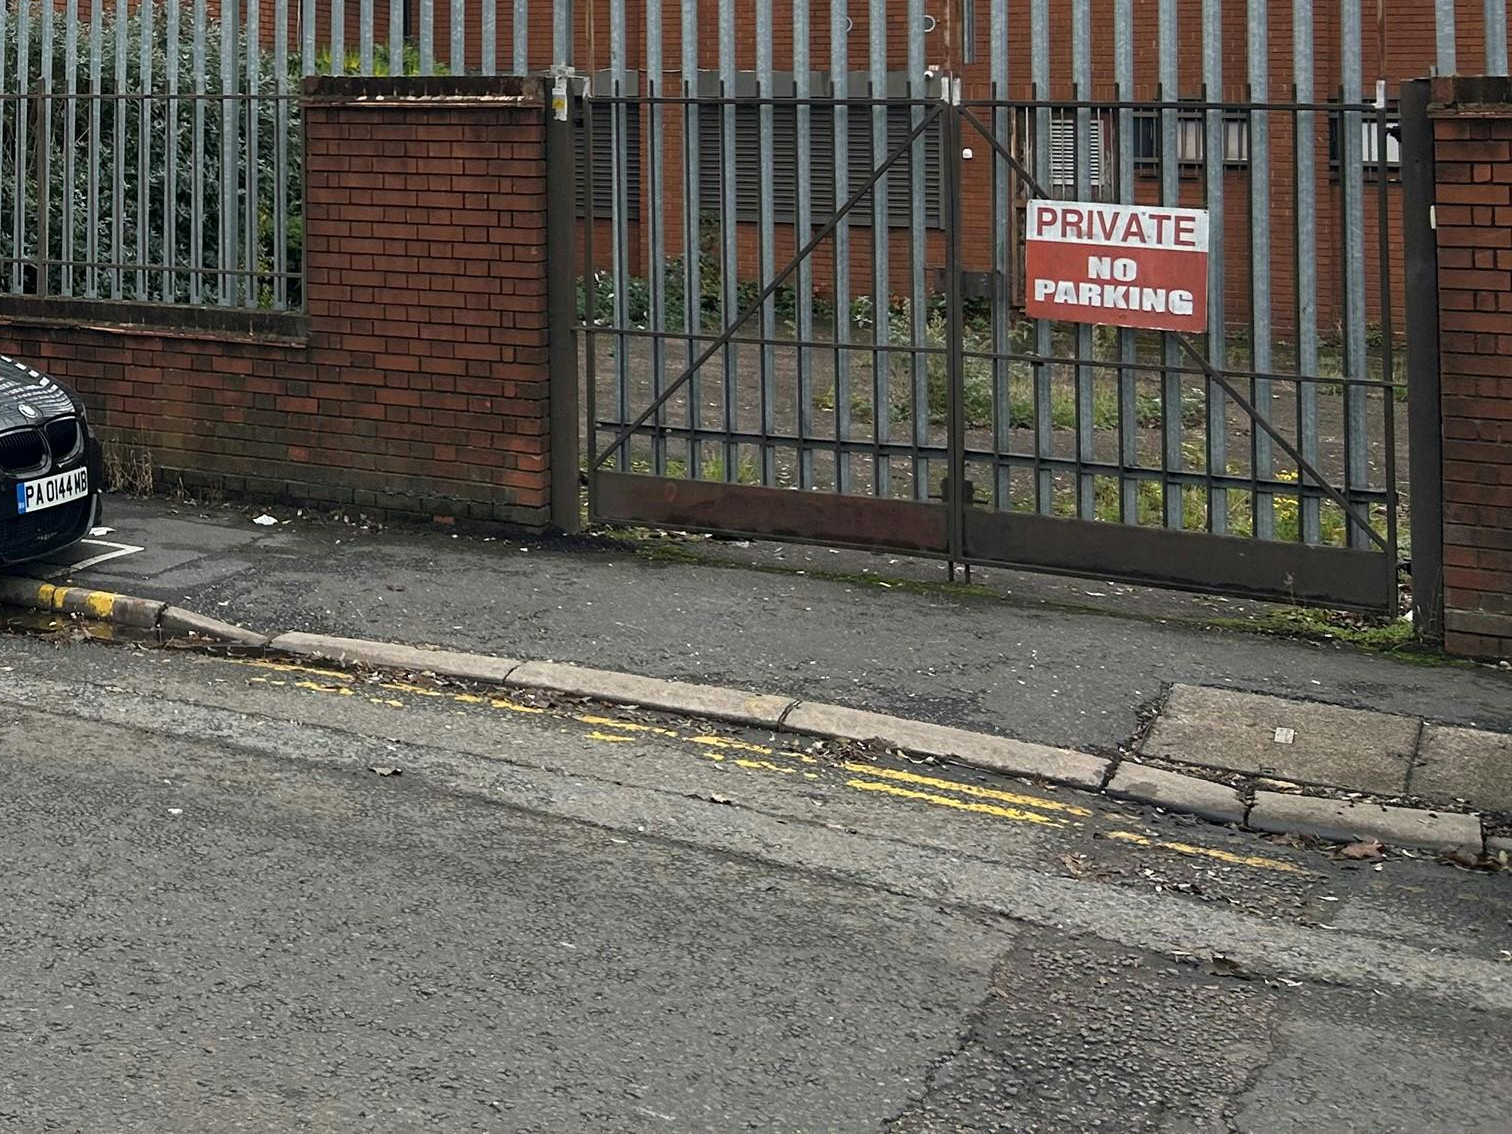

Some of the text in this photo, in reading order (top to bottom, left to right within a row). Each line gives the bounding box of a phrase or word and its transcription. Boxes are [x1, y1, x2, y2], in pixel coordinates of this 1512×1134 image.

[1036, 207, 1196, 247] PRIVATE
[1087, 256, 1138, 282] NO
[1034, 278, 1194, 316] PARKING
